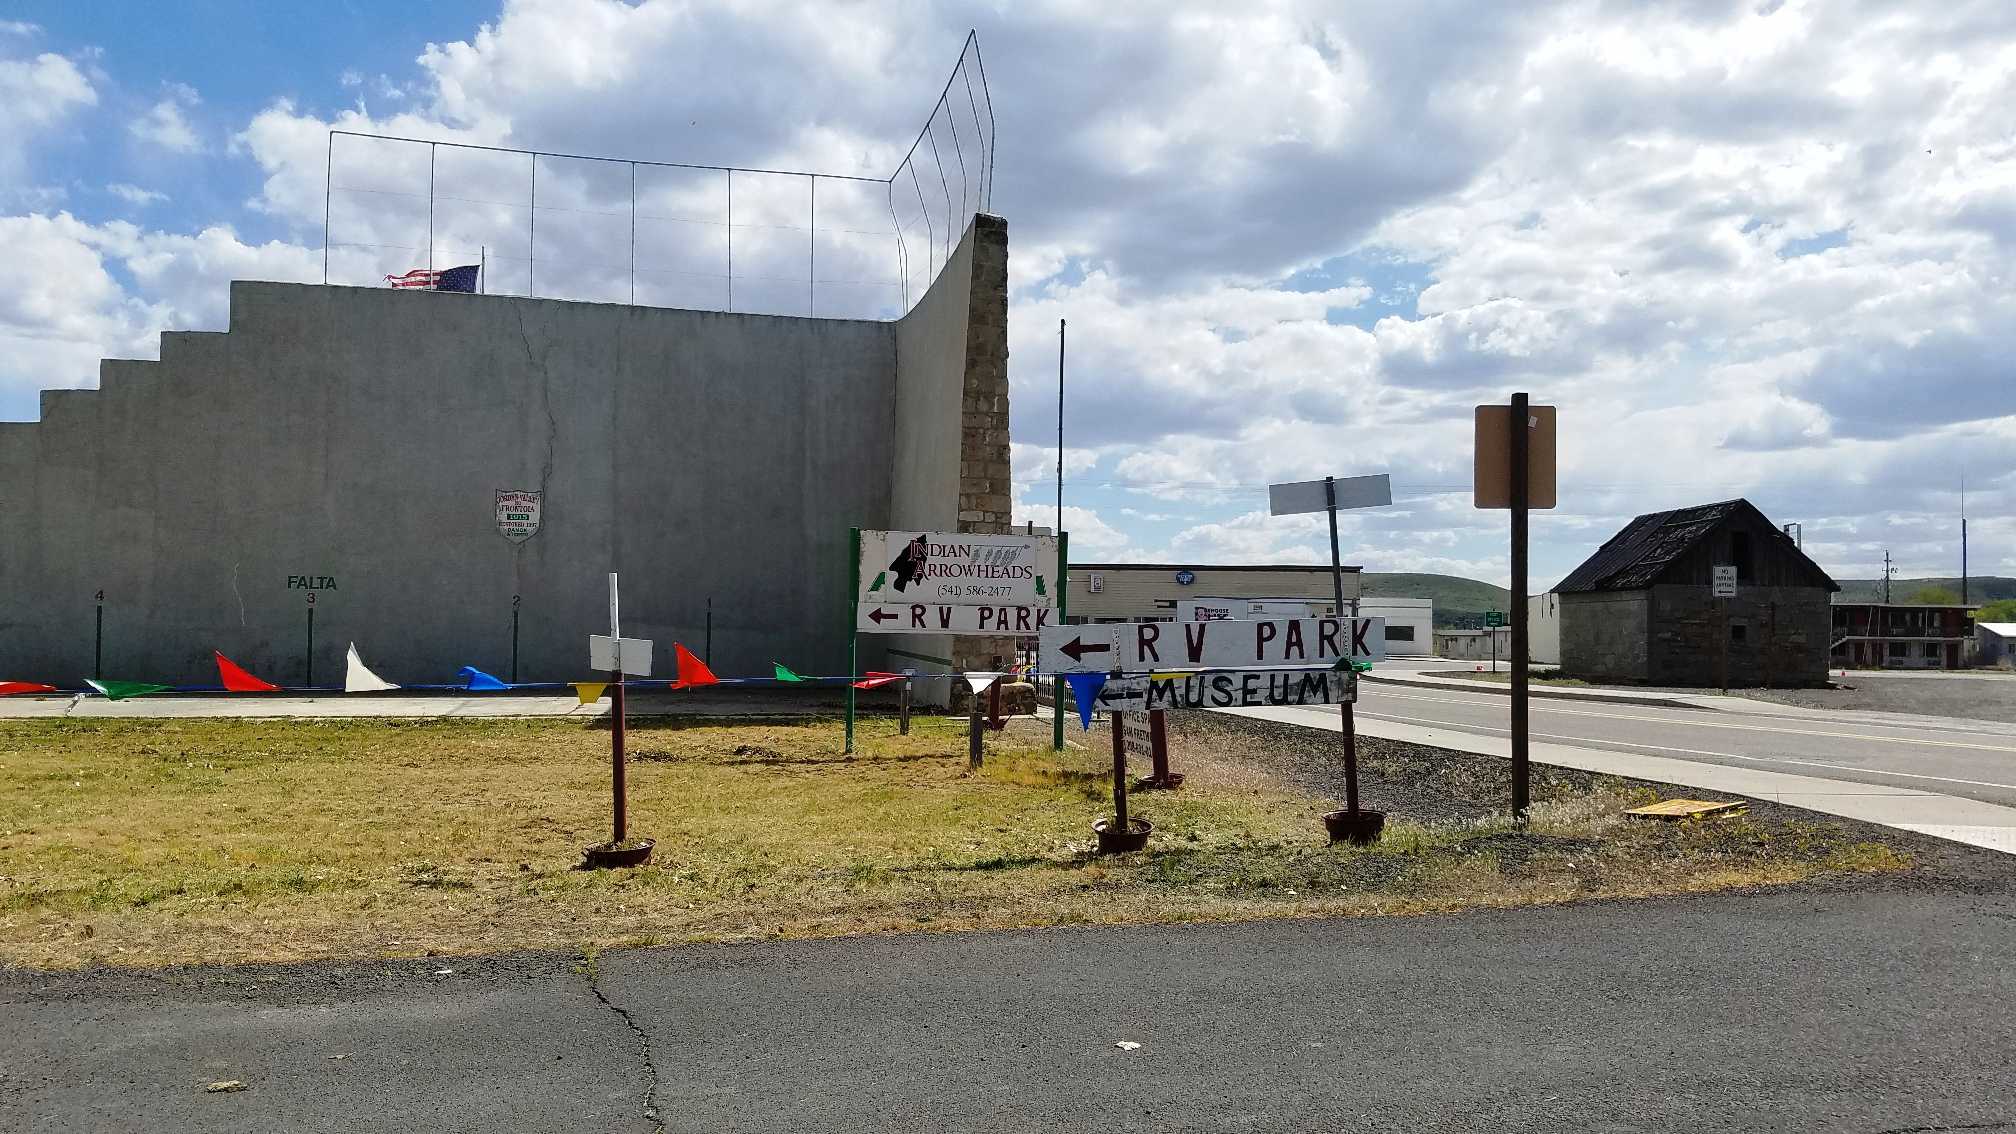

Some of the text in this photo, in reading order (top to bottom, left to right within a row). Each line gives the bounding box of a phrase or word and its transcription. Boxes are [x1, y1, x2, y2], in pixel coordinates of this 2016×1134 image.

[909, 540, 971, 562] INDIAN
[912, 560, 1033, 581] ARROWHEADS
[287, 575, 337, 591] FALTA
[937, 585, 1012, 598] (541) 586-2477
[94, 590, 105, 600] 4
[306, 592, 316, 604] 3
[512, 595, 520, 607] 2
[910, 603, 1050, 632] RV PARK
[1137, 618, 1373, 663] RV PARK
[1145, 671, 1330, 710] MUSEUM
